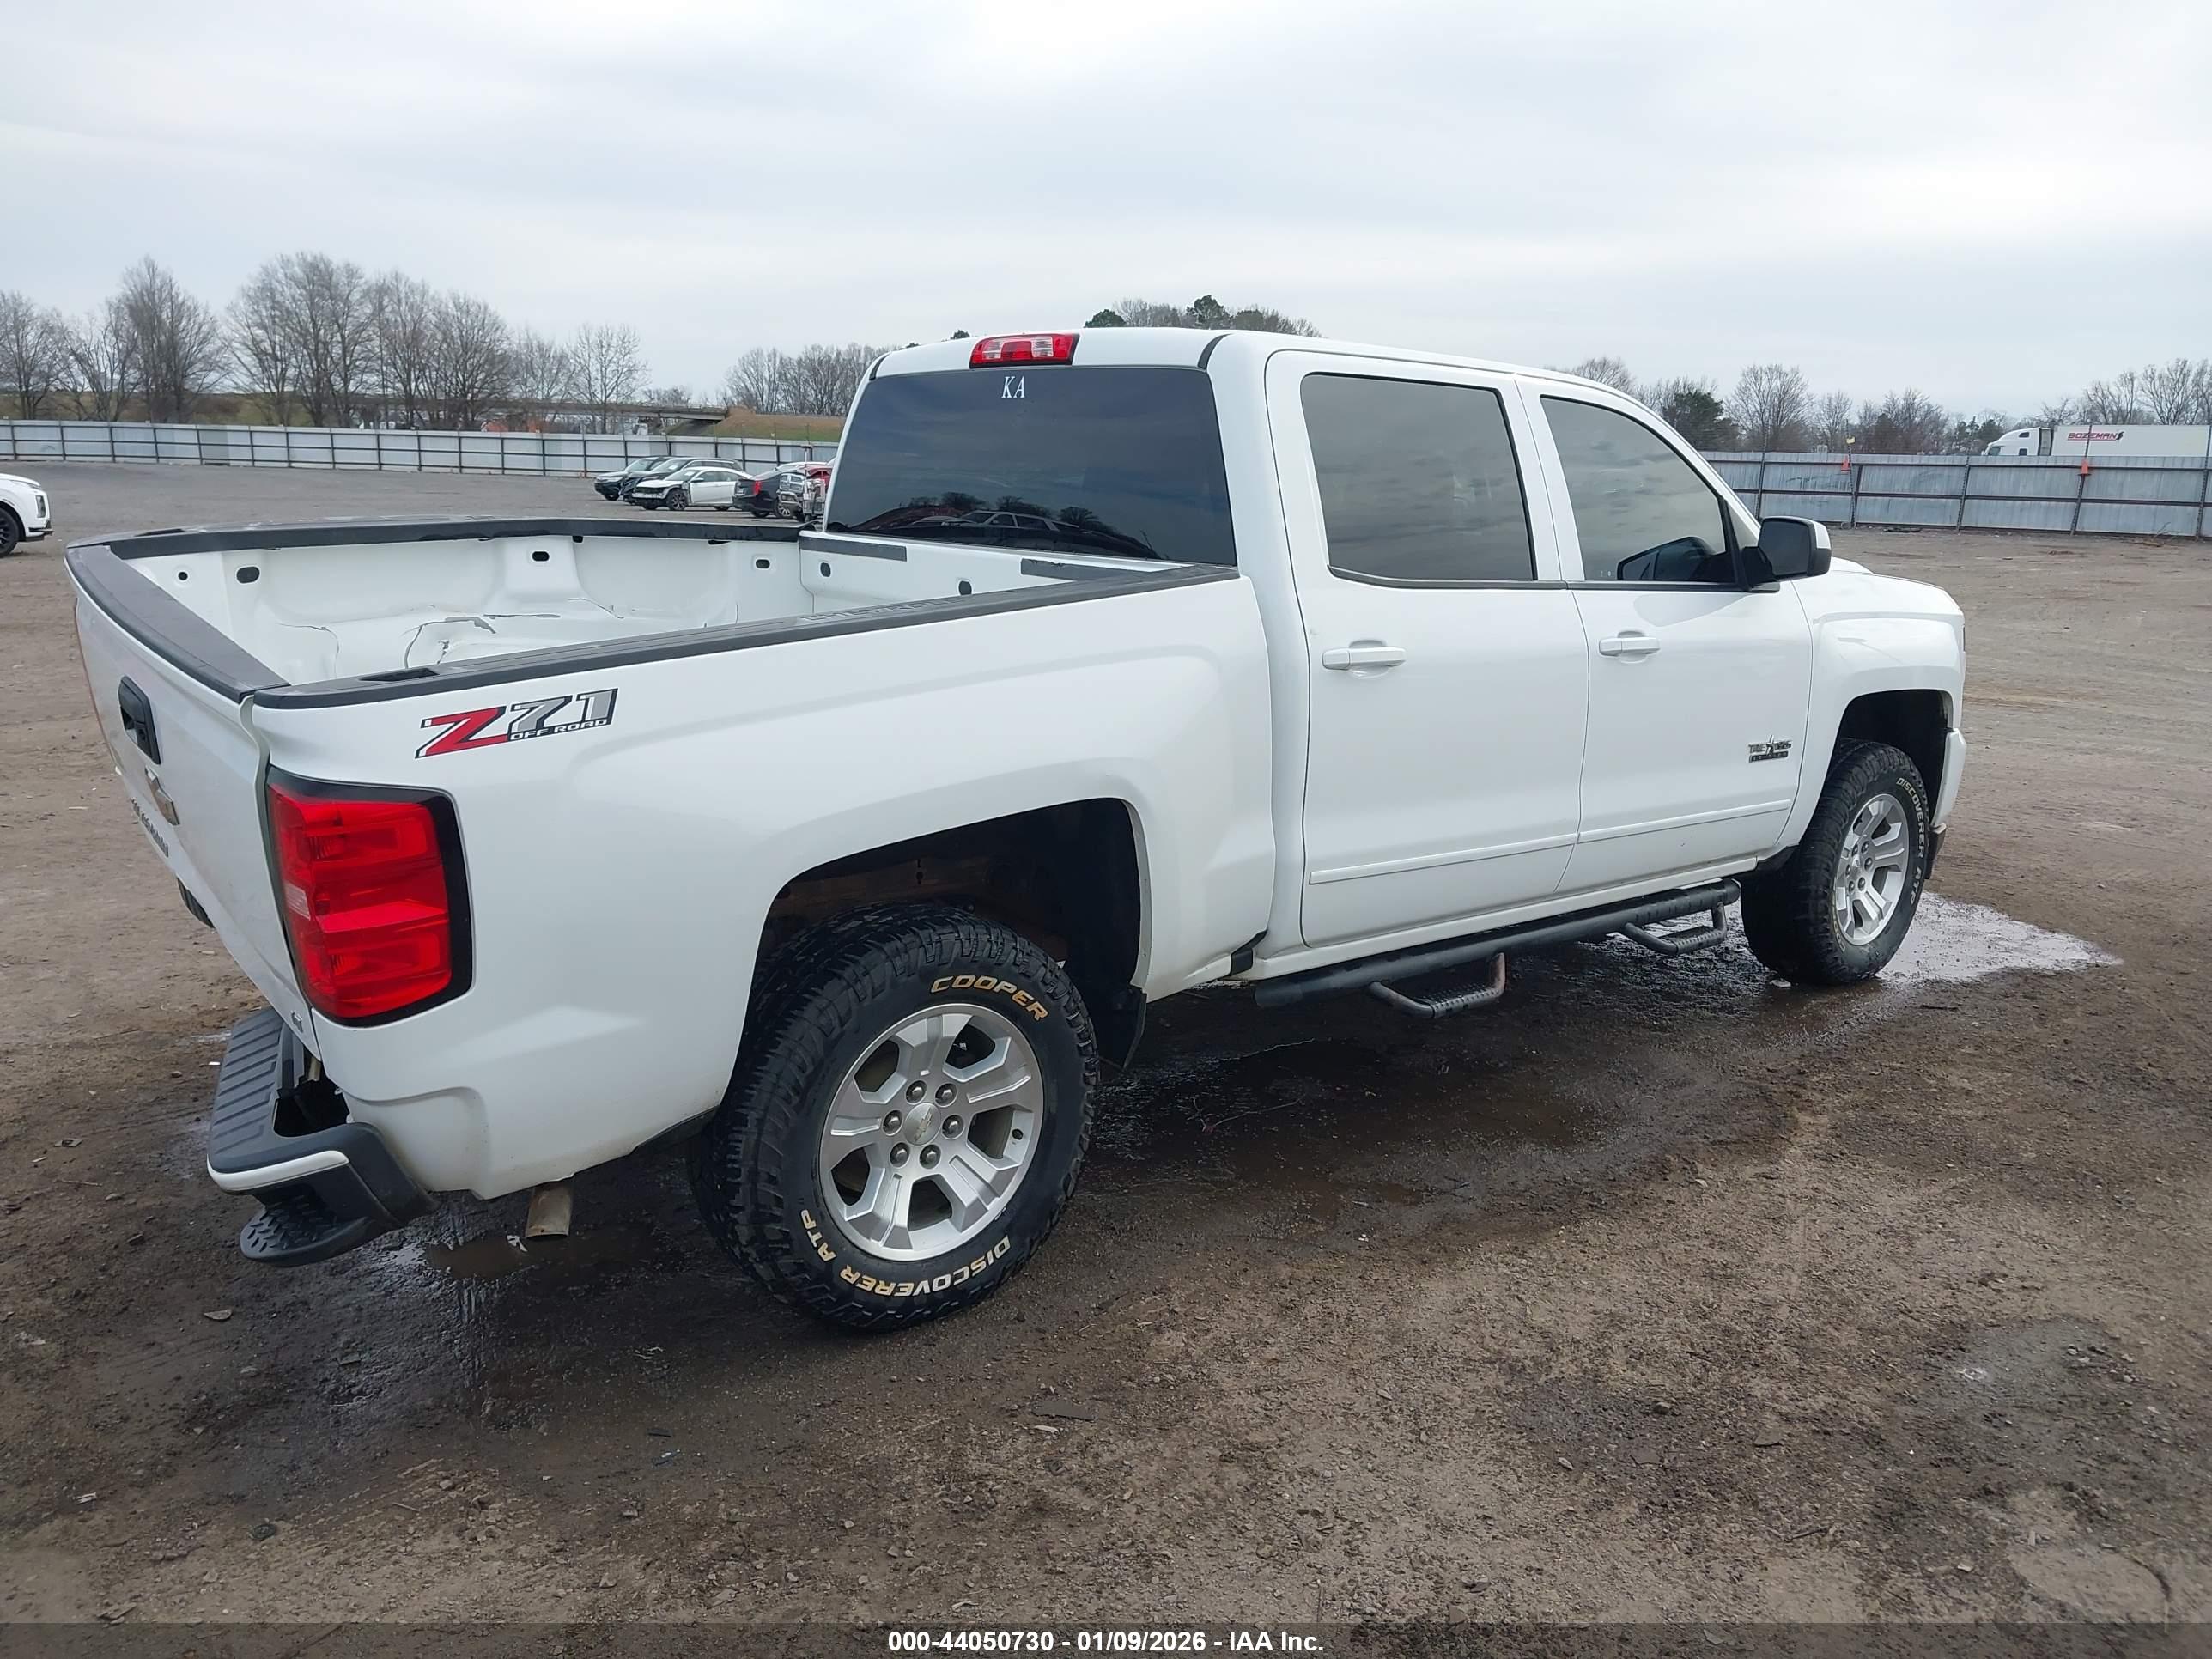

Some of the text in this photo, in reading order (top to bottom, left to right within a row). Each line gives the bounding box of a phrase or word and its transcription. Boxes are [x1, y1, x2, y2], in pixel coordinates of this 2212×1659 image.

[1000, 375, 1025, 398] KA
[415, 688, 619, 758] Z71
[509, 718, 608, 741] OFF ROAD
[1896, 777, 1924, 858] DISCOVERER
[930, 975, 1049, 1022] COOPER
[800, 1209, 1011, 1297] DISCOVERER ATP
